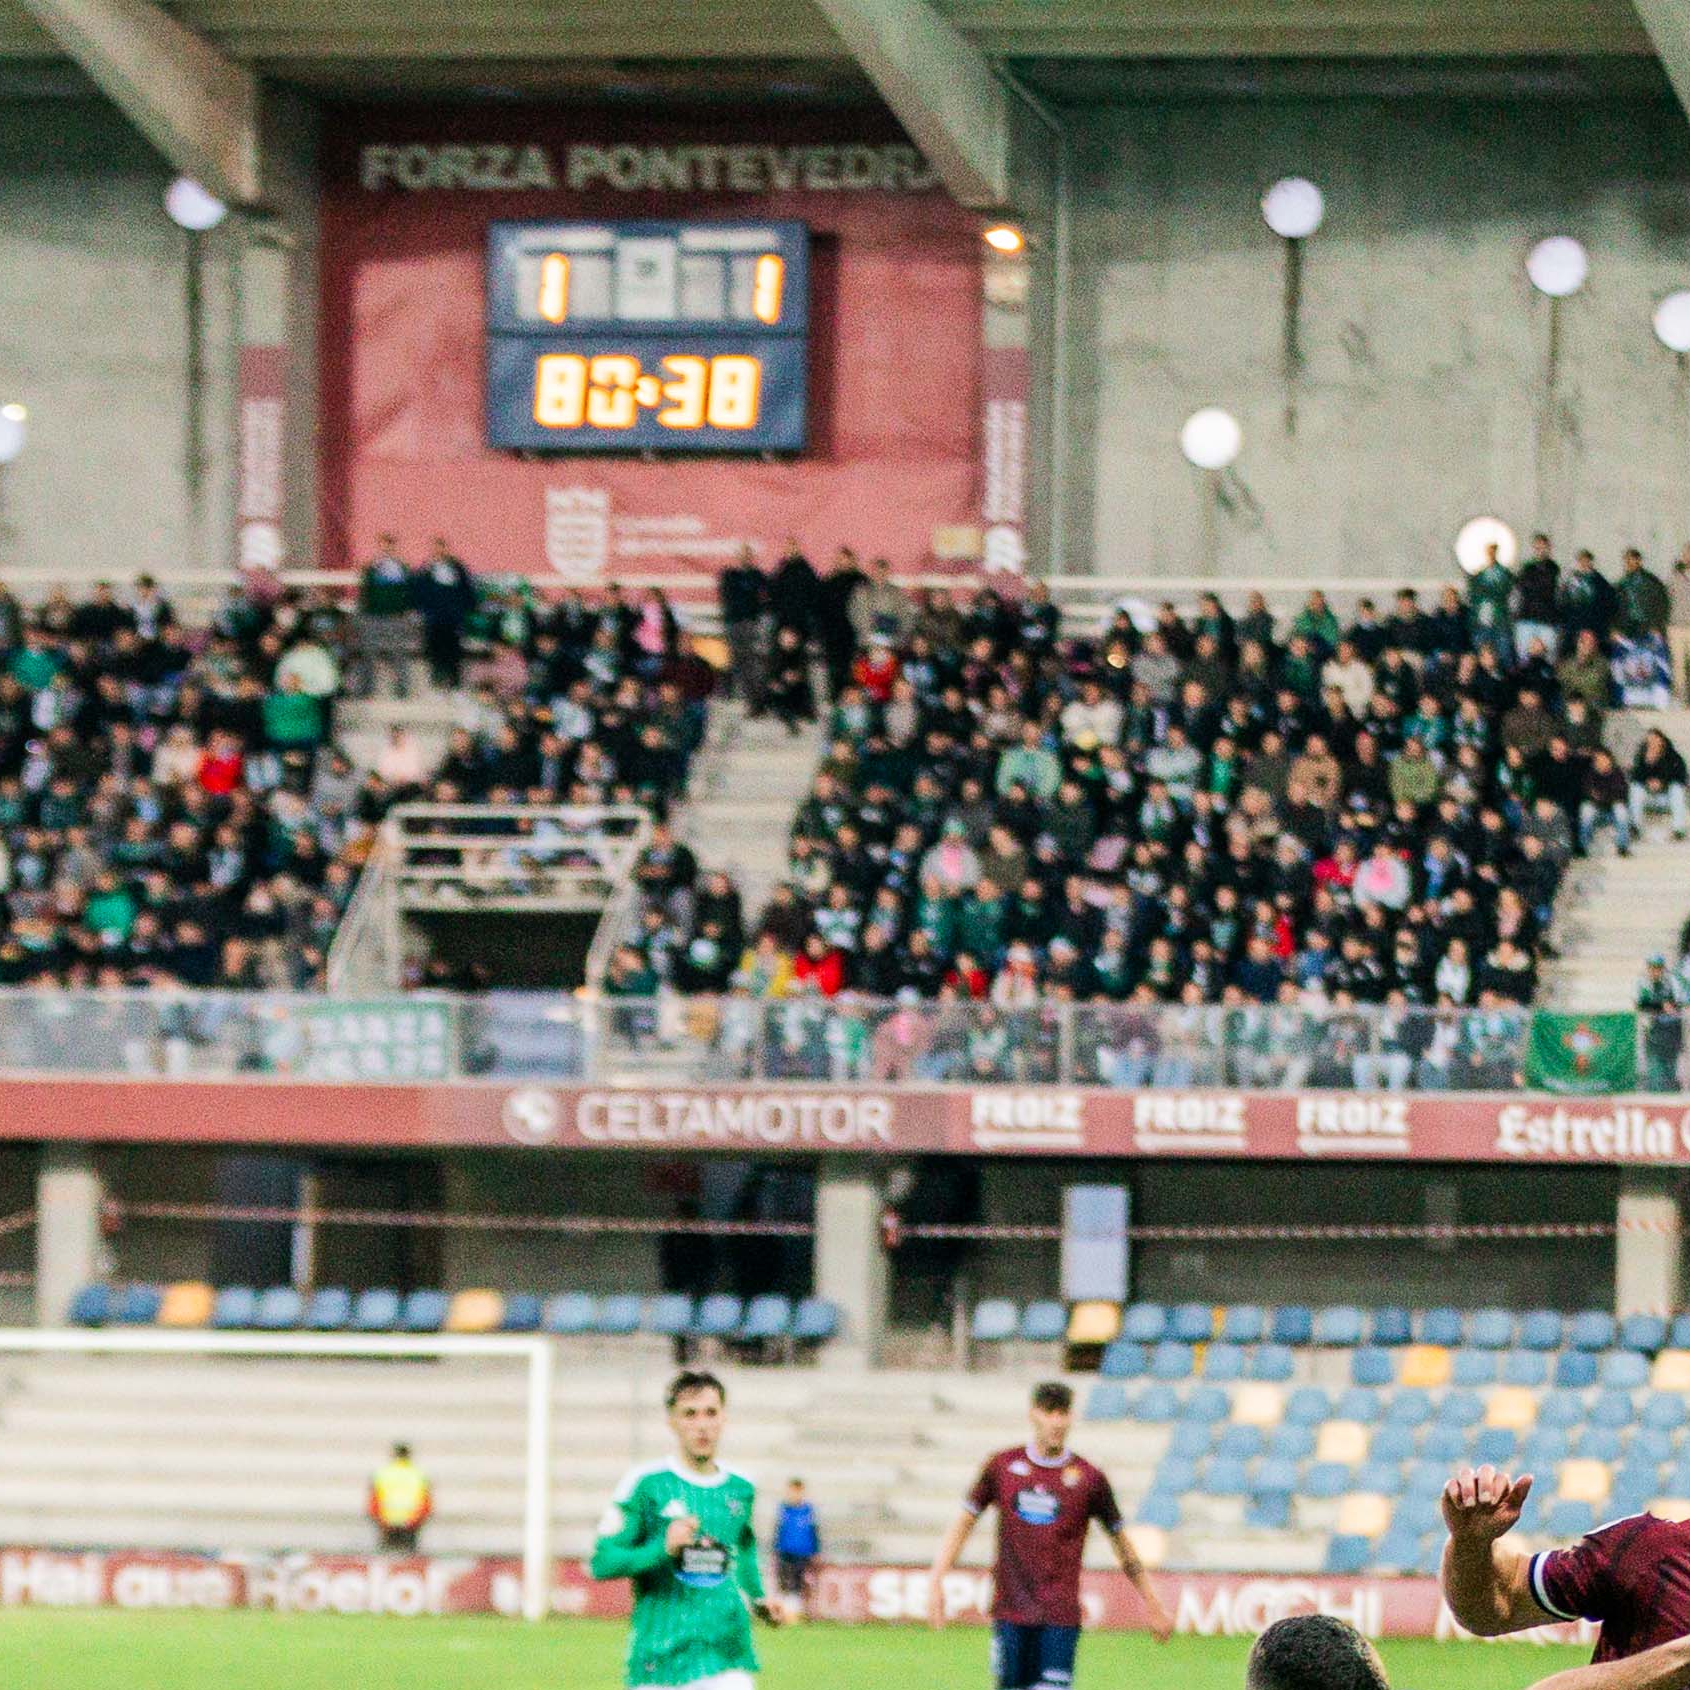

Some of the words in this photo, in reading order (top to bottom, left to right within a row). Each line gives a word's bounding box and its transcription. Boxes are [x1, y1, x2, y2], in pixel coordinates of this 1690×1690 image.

[360, 144, 557, 190] FORZA
[535, 251, 570, 325] 1
[752, 252, 784, 325] 1
[575, 1095, 897, 1144] CELTAMOTOR
[971, 1094, 1085, 1131] FROIZ
[1135, 1097, 1245, 1132] FROIZ
[1296, 1099, 1408, 1133] FROIZ
[1495, 1106, 1675, 1157] Estrella
